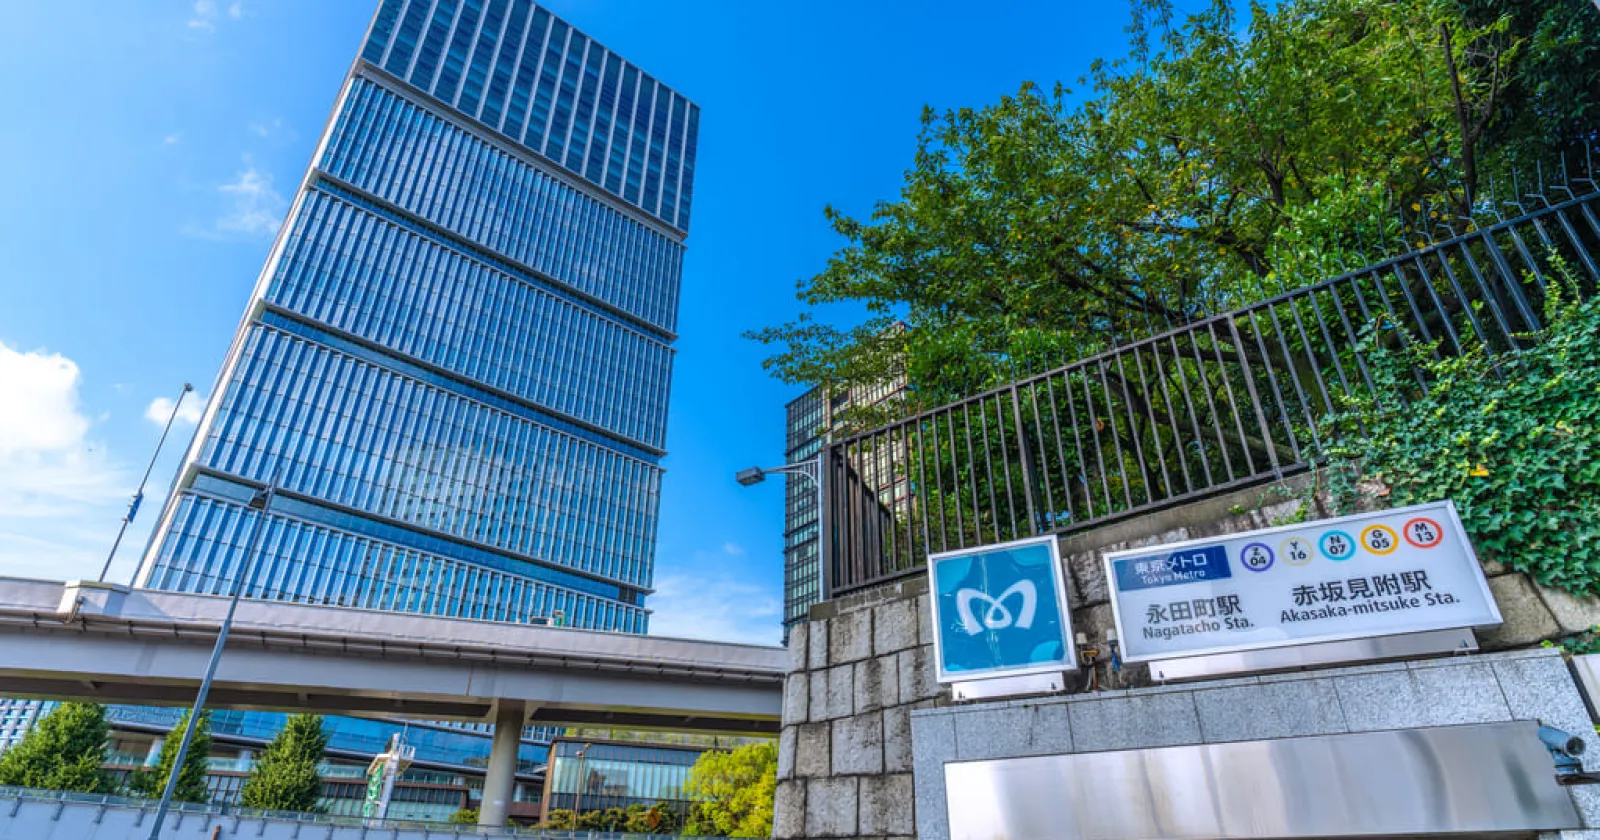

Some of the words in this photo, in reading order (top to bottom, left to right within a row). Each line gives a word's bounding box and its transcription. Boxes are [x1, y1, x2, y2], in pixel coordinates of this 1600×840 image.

[1414, 522, 1428, 532] M
[1329, 535, 1341, 544] N
[1371, 529, 1383, 539] G
[1415, 531, 1435, 542] 13
[1290, 541, 1298, 550] Y
[1329, 543, 1346, 555] 07
[1371, 538, 1390, 549] 05
[1290, 550, 1307, 560] 16
[1135, 553, 1207, 575] 東京メトロ
[1250, 556, 1266, 567] 04
[1143, 574, 1172, 585] Tokyo
[1172, 569, 1206, 581] Metro
[1291, 569, 1432, 606] 赤坂見附駅
[1145, 594, 1243, 625] 永田町駅
[1280, 595, 1421, 624] Akasaka-mitsuke
[1424, 591, 1461, 608] Sta.
[1143, 620, 1220, 640] Nagatacho
[1224, 617, 1255, 630] Sta.
